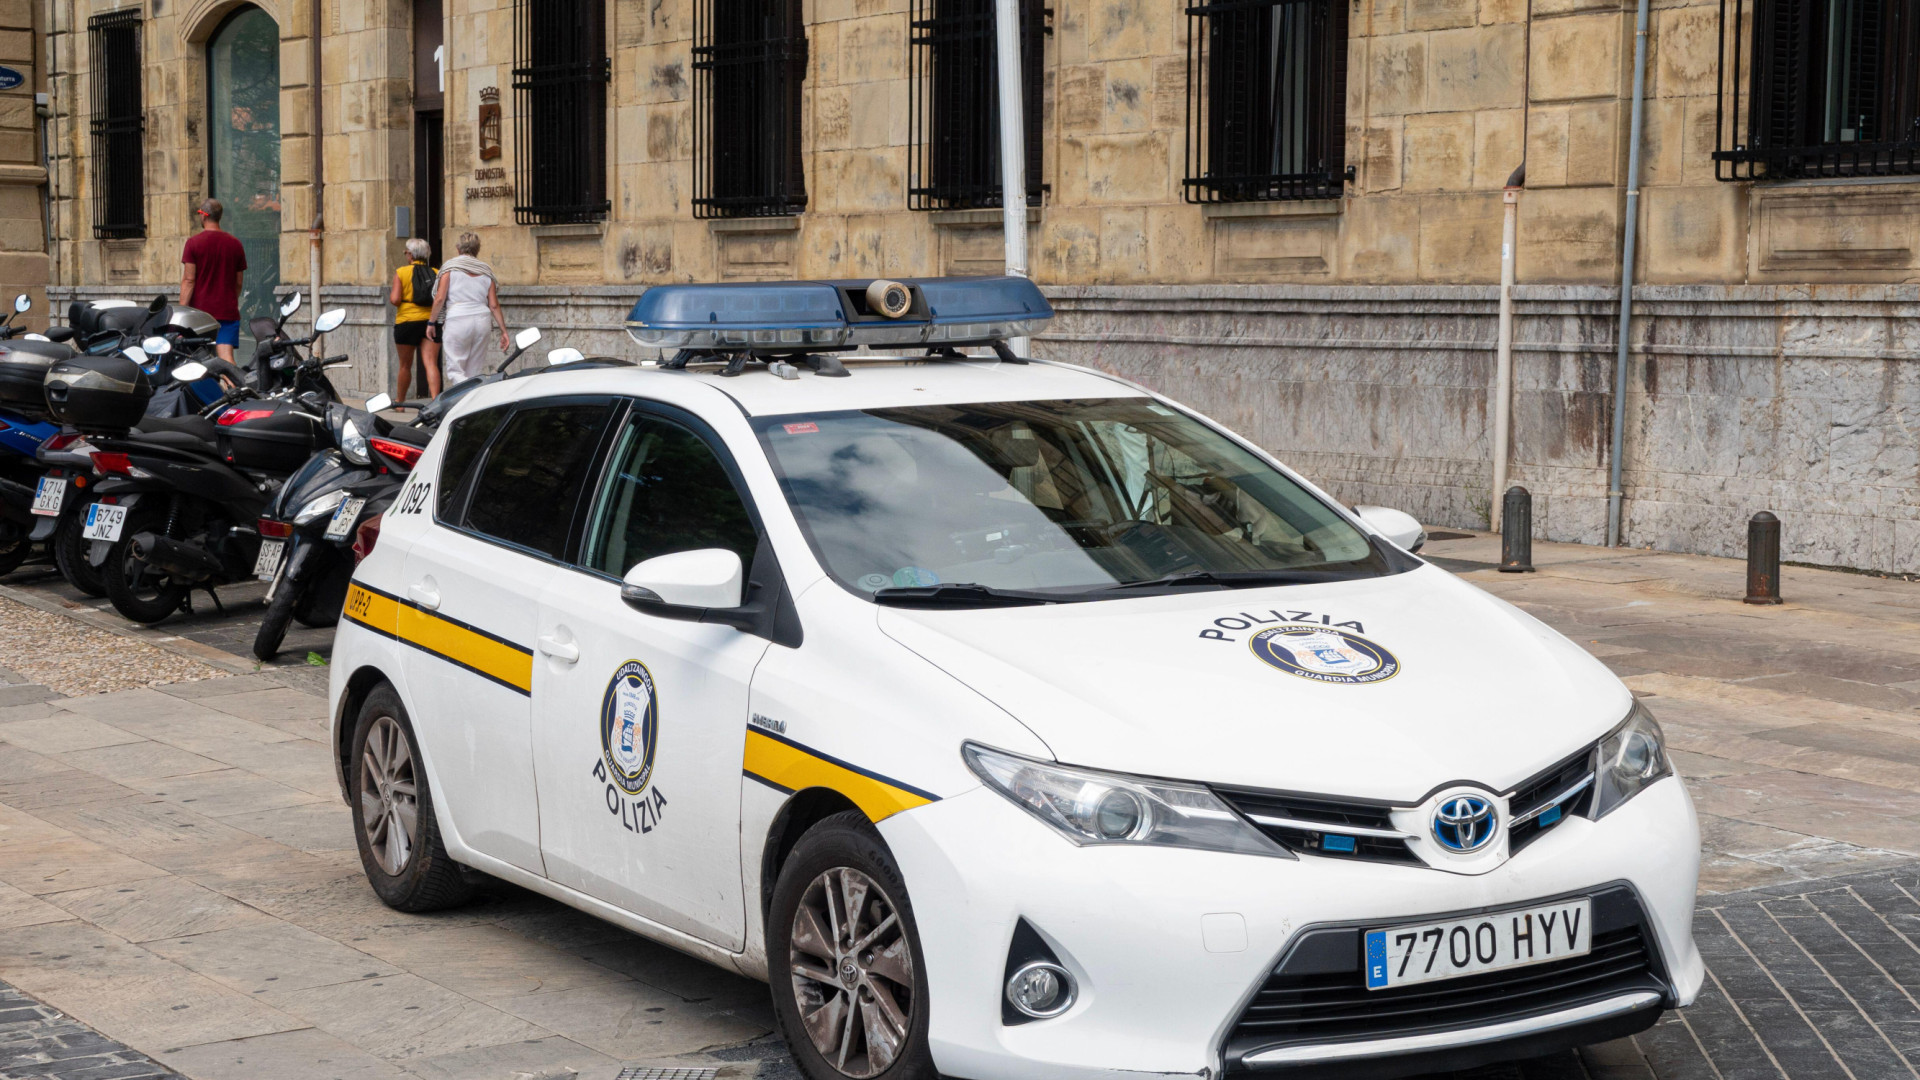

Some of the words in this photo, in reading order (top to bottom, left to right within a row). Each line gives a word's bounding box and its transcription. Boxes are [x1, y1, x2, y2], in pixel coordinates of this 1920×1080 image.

[475, 167, 506, 180] DONOSTIA
[42, 480, 63, 496] 4714
[400, 482, 431, 515] 092
[96, 508, 123, 525] 6749
[92, 524, 113, 539] JNZ
[257, 557, 276, 573] 5414
[1198, 609, 1365, 642] POLIZIA
[1256, 626, 1340, 640] UDALTZAINGOA
[616, 663, 653, 694] UDALTZAINGOA
[1294, 669, 1355, 683] GUARDIA
[1357, 662, 1397, 683] MUNICIPAL
[605, 749, 626, 788] GUARDIA
[626, 764, 651, 791] MUNICIPAL
[592, 757, 668, 835] POLIZIA
[1373, 965, 1383, 979] E
[1395, 922, 1497, 978] 7700
[1512, 907, 1581, 960] HYV
